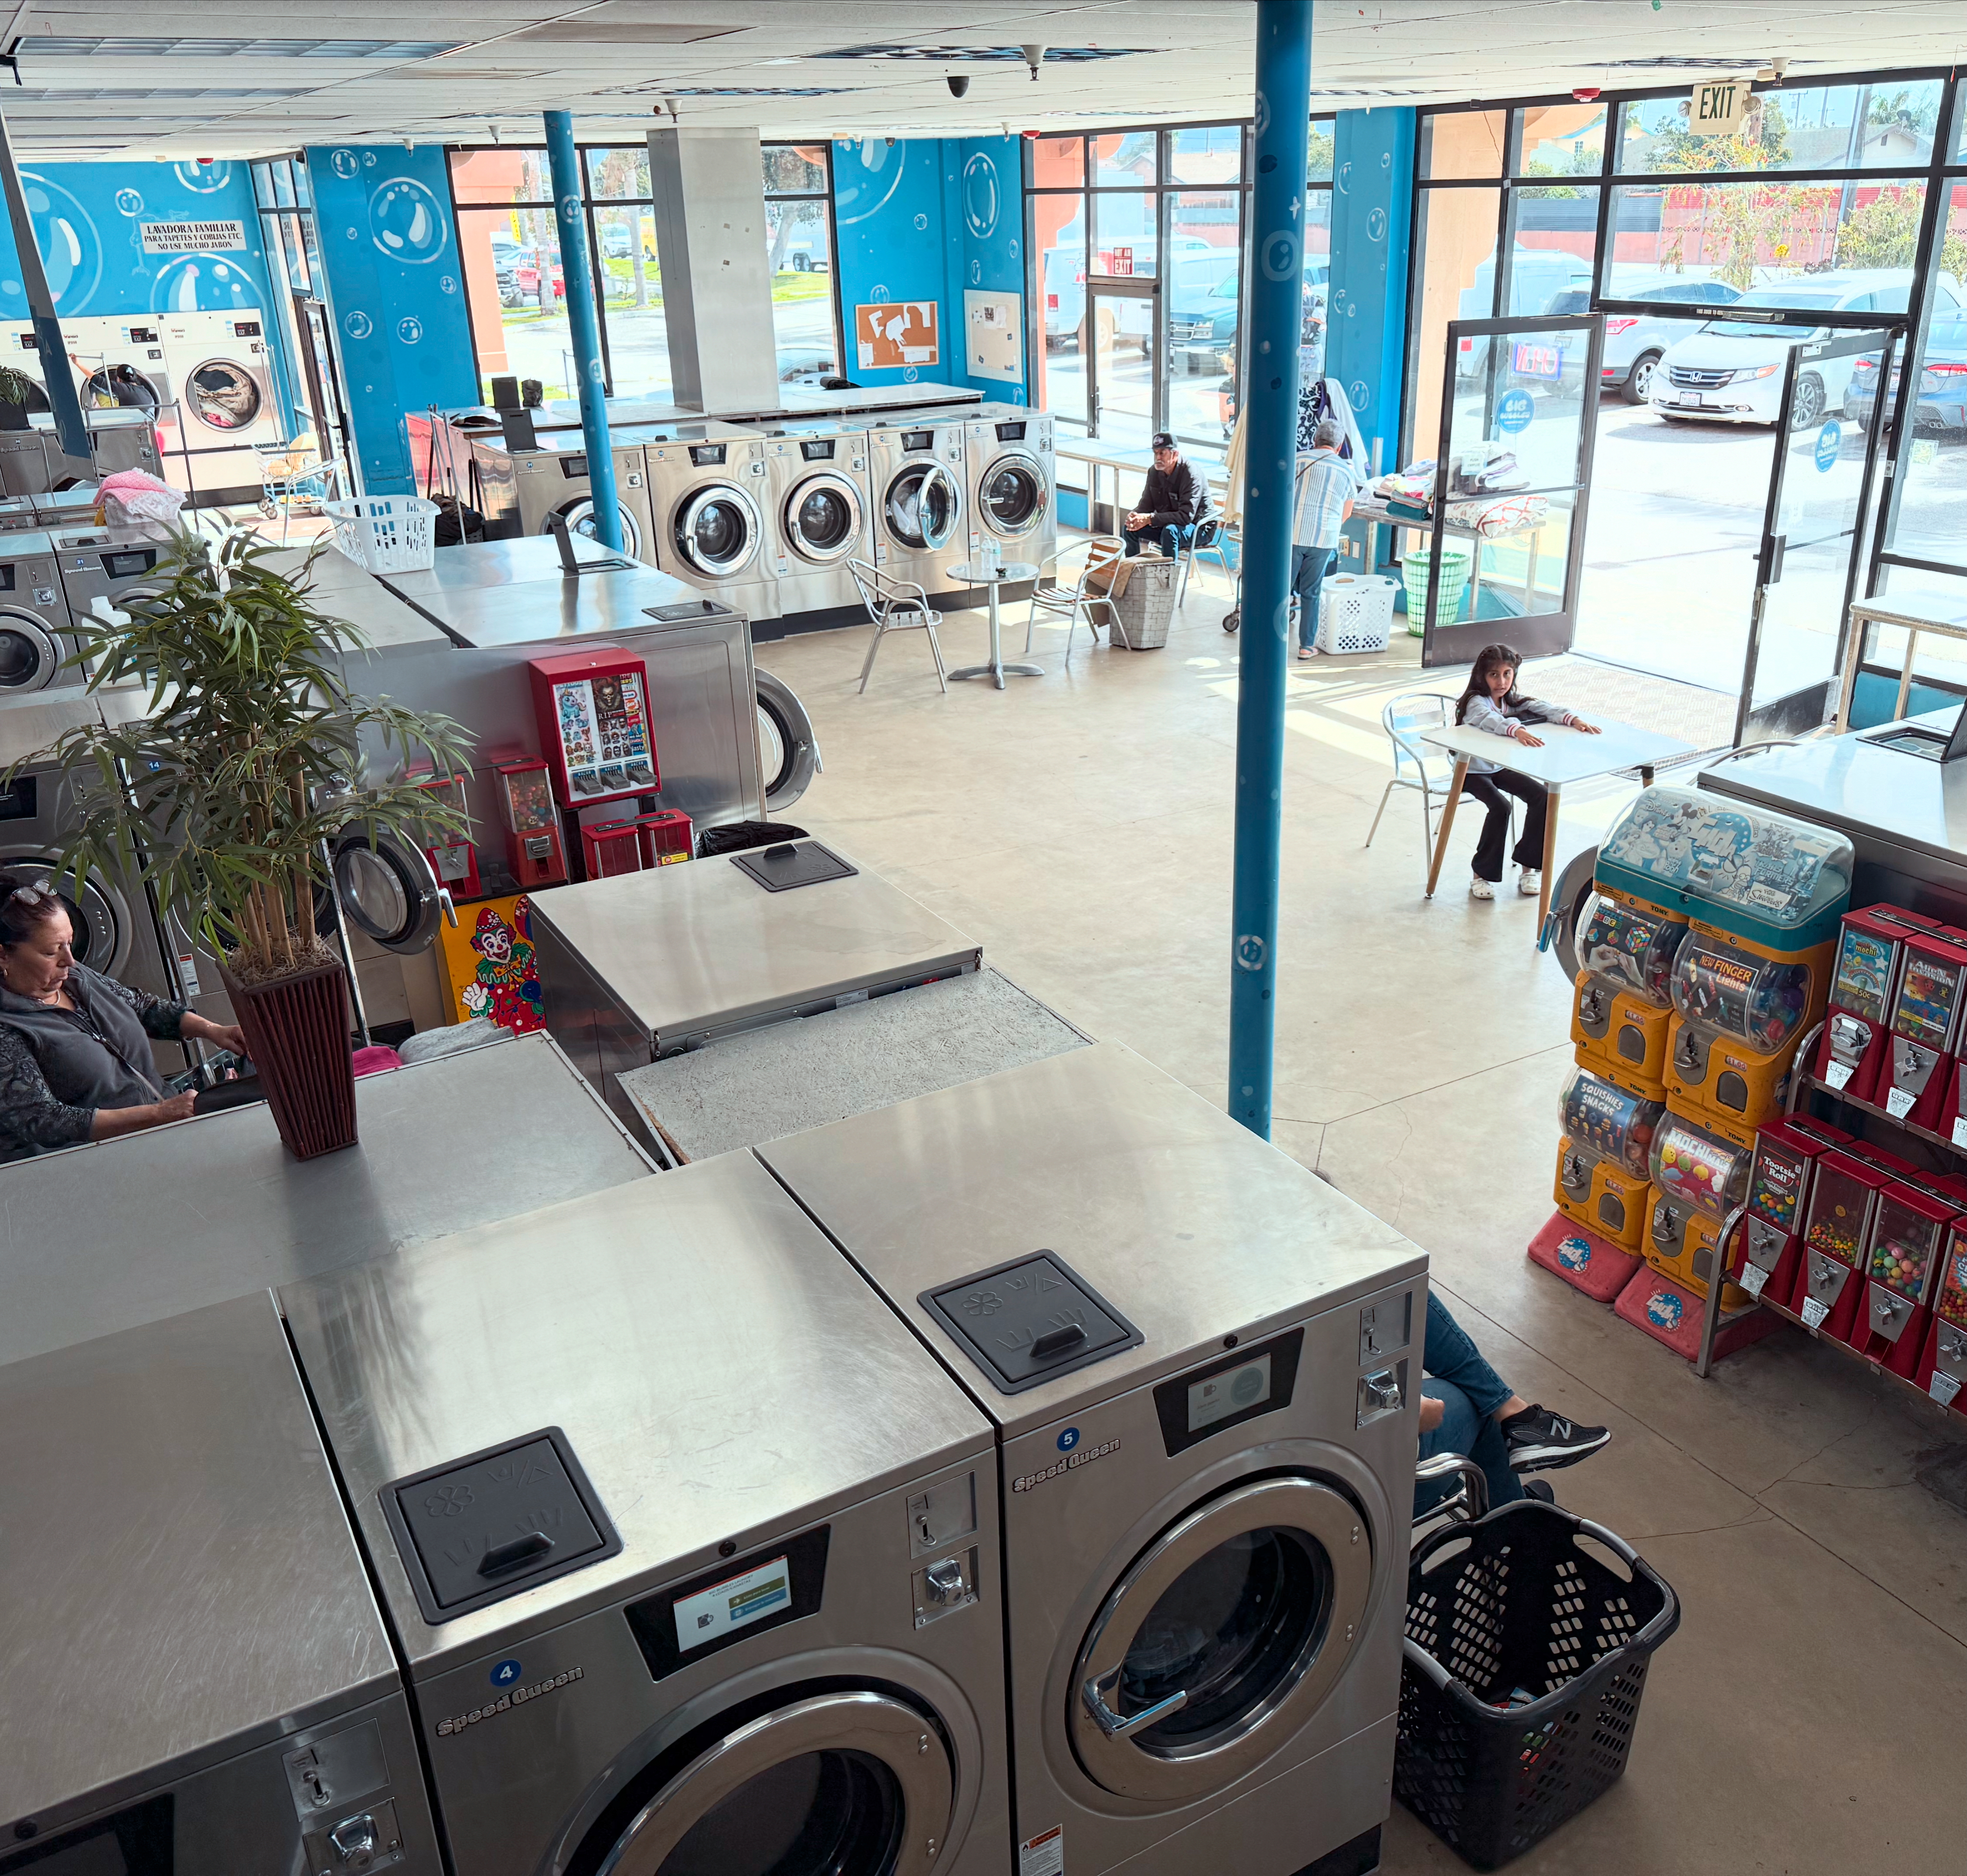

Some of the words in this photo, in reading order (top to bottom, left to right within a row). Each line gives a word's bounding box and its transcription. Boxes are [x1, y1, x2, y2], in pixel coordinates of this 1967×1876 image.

[1699, 86, 1736, 119] EXIT
[147, 225, 193, 234] LAVADORA
[195, 223, 236, 233] FAMILIAR
[1115, 259, 1131, 274] EXIT
[1650, 905, 1669, 916] TOMY
[1856, 944, 1878, 956] mochi
[1699, 955, 1715, 969] NEW
[1714, 959, 1752, 983] FINGER
[1716, 972, 1747, 993] Lights
[1581, 1082, 1624, 1110] SQUISHIES
[1629, 1082, 1647, 1095] TOMY
[1582, 1094, 1615, 1116] SNACKS
[1728, 1132, 1746, 1144] TOMY
[1764, 1156, 1796, 1179] Tootsie
[1769, 1168, 1787, 1183] Roll
[1703, 1234, 1716, 1245] $1.0
[1550, 1418, 1571, 1440] N
[1064, 1432, 1073, 1445] 5
[1013, 1457, 1069, 1493] Speed
[1068, 1438, 1121, 1469] Queen
[500, 1665, 513, 1679] 4
[436, 1693, 513, 1737] Speed
[512, 1666, 585, 1706] Queen
